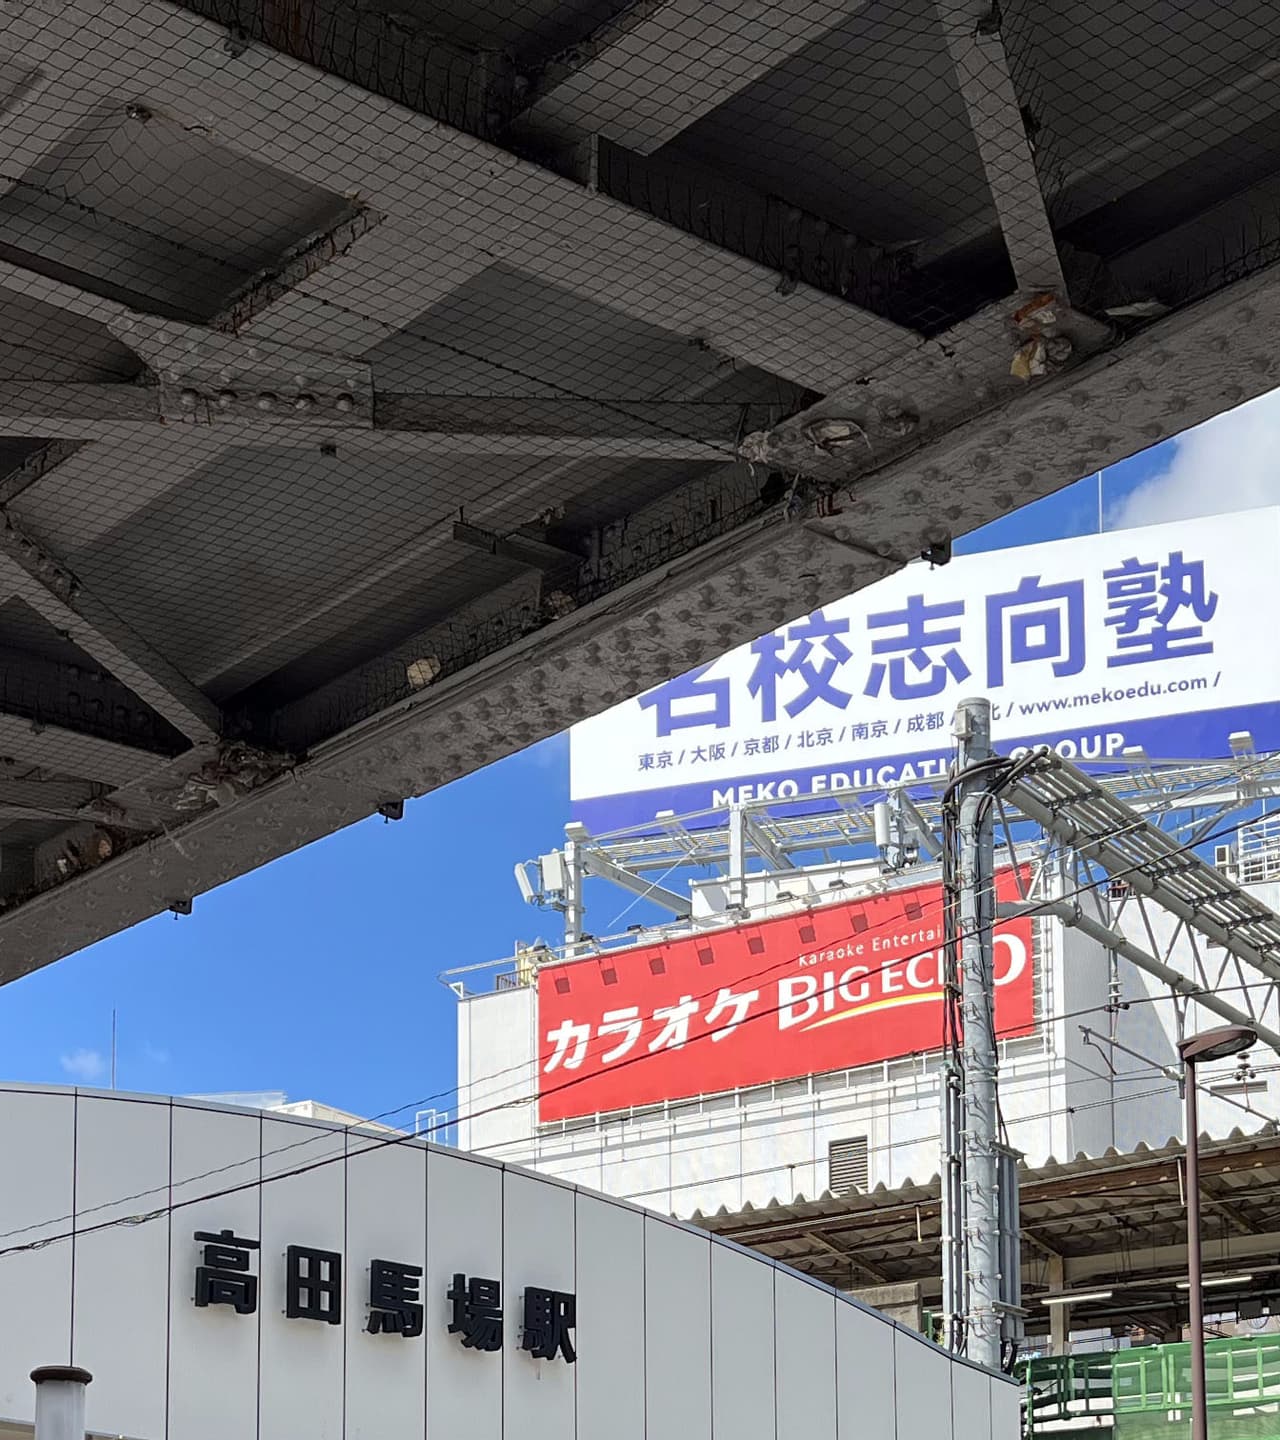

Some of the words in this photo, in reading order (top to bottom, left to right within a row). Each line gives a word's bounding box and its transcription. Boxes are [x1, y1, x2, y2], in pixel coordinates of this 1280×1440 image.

[1019, 677, 1208, 715] www.mekoedu.com
[811, 757, 958, 794] EDUCATI
[799, 943, 864, 967] Karaoke
[543, 987, 761, 1073] カラオケ
[778, 965, 870, 1031] BIG
[193, 1229, 577, 1365] 高田馬場駅
